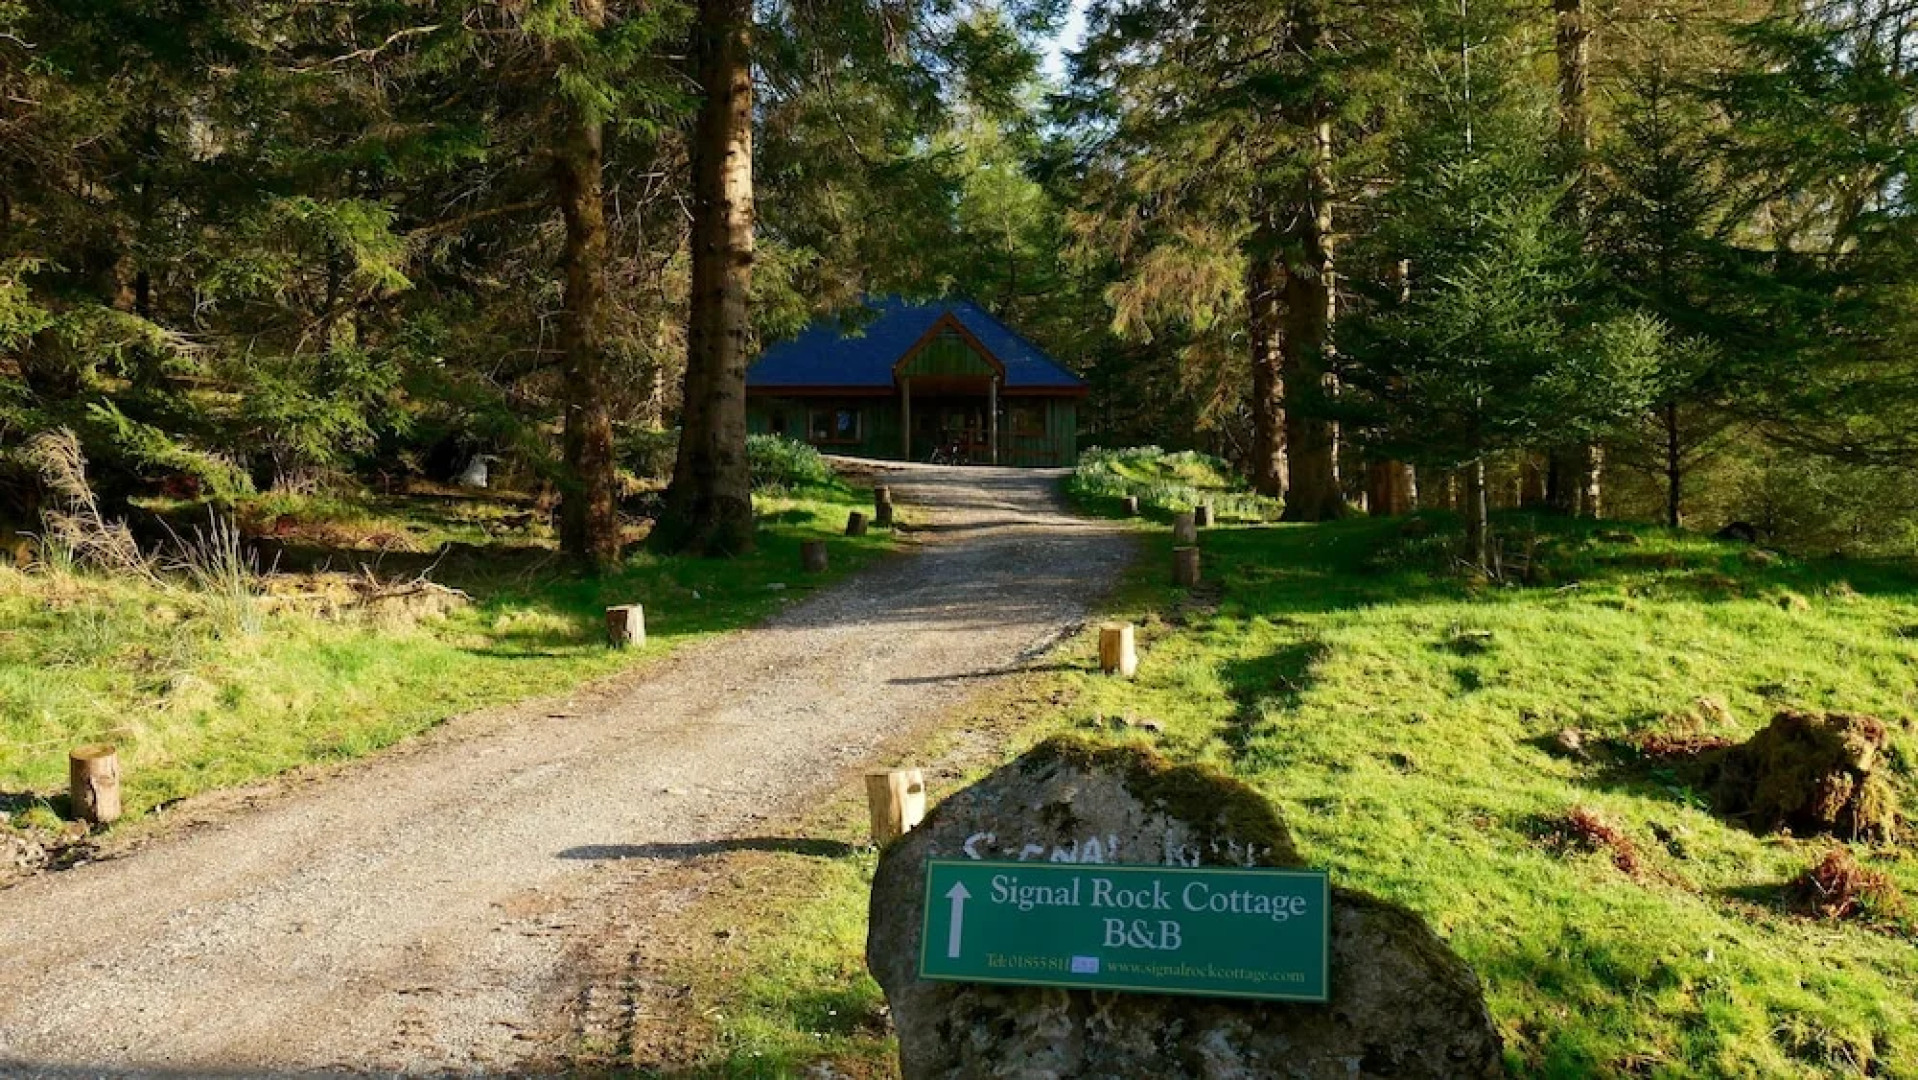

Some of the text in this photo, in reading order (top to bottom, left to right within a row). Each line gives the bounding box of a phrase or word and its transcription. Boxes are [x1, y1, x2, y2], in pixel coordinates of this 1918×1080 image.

[990, 874, 1308, 921] Signal Rock Cottage
[1102, 917, 1183, 951] B&B
[1106, 960, 1305, 983] www.signalrockcottage.com
